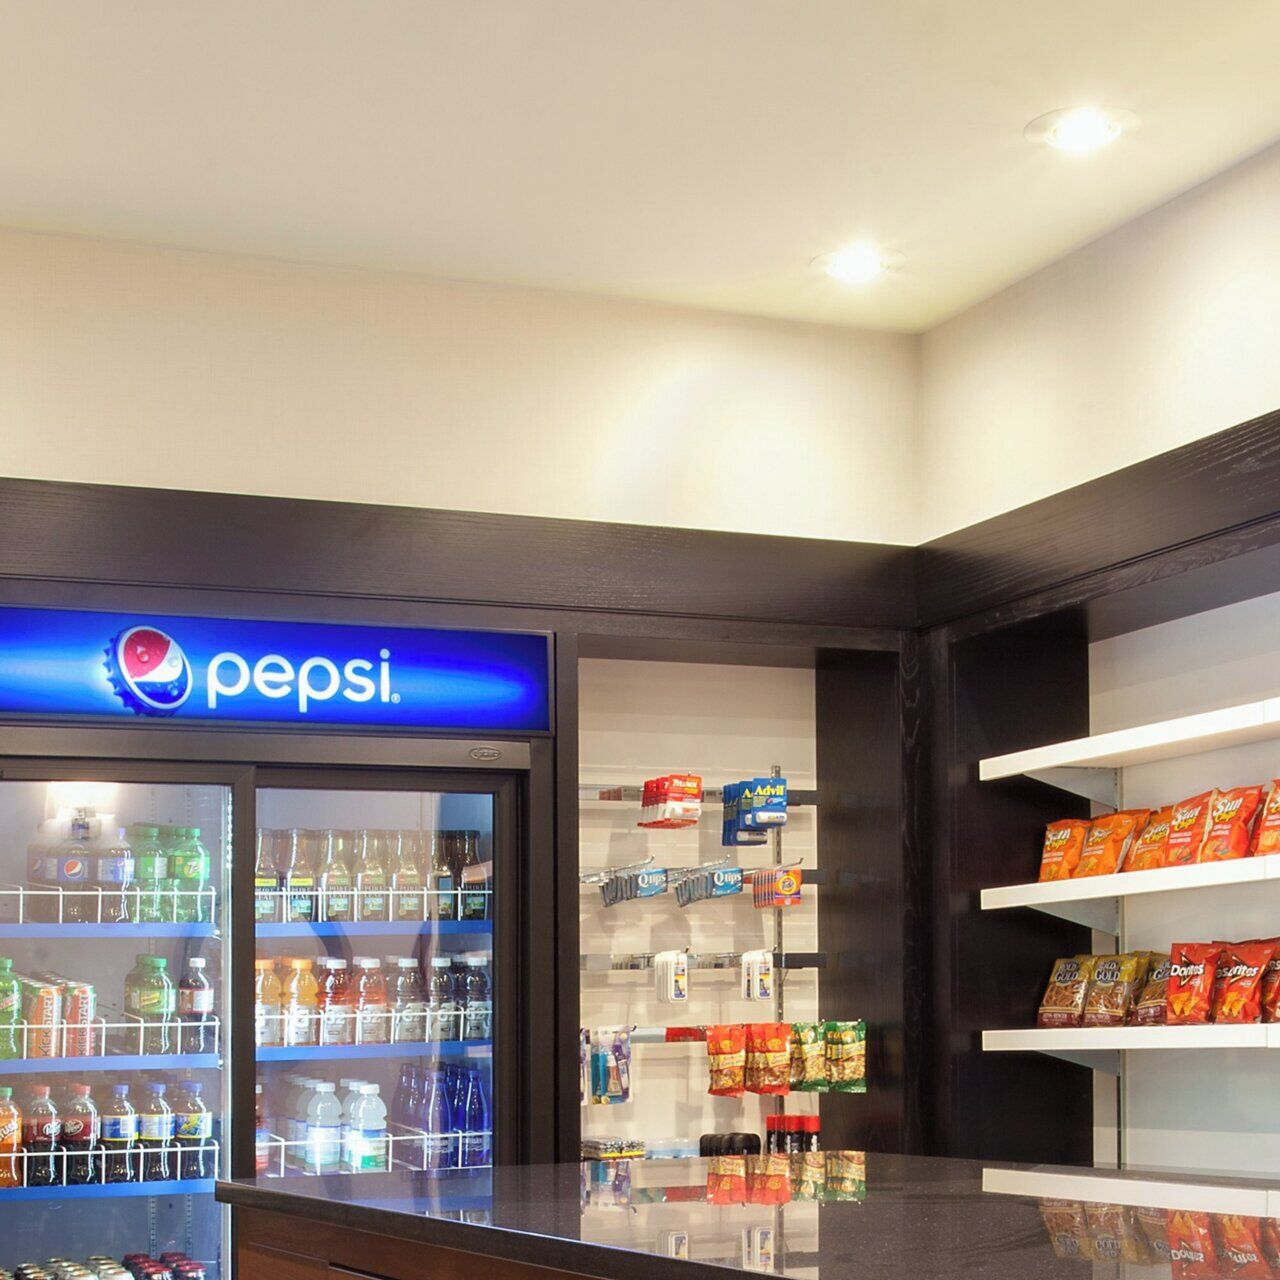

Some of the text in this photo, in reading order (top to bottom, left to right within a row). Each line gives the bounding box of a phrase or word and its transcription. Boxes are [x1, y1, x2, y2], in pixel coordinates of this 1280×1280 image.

[207, 648, 391, 713] pepsi
[754, 785, 784, 796] Advil
[1213, 797, 1243, 817] Sun
[1171, 806, 1202, 826] Sun
[1055, 970, 1079, 982] GOLD
[1095, 969, 1120, 981] GOLD
[1170, 964, 1204, 977] Doritos
